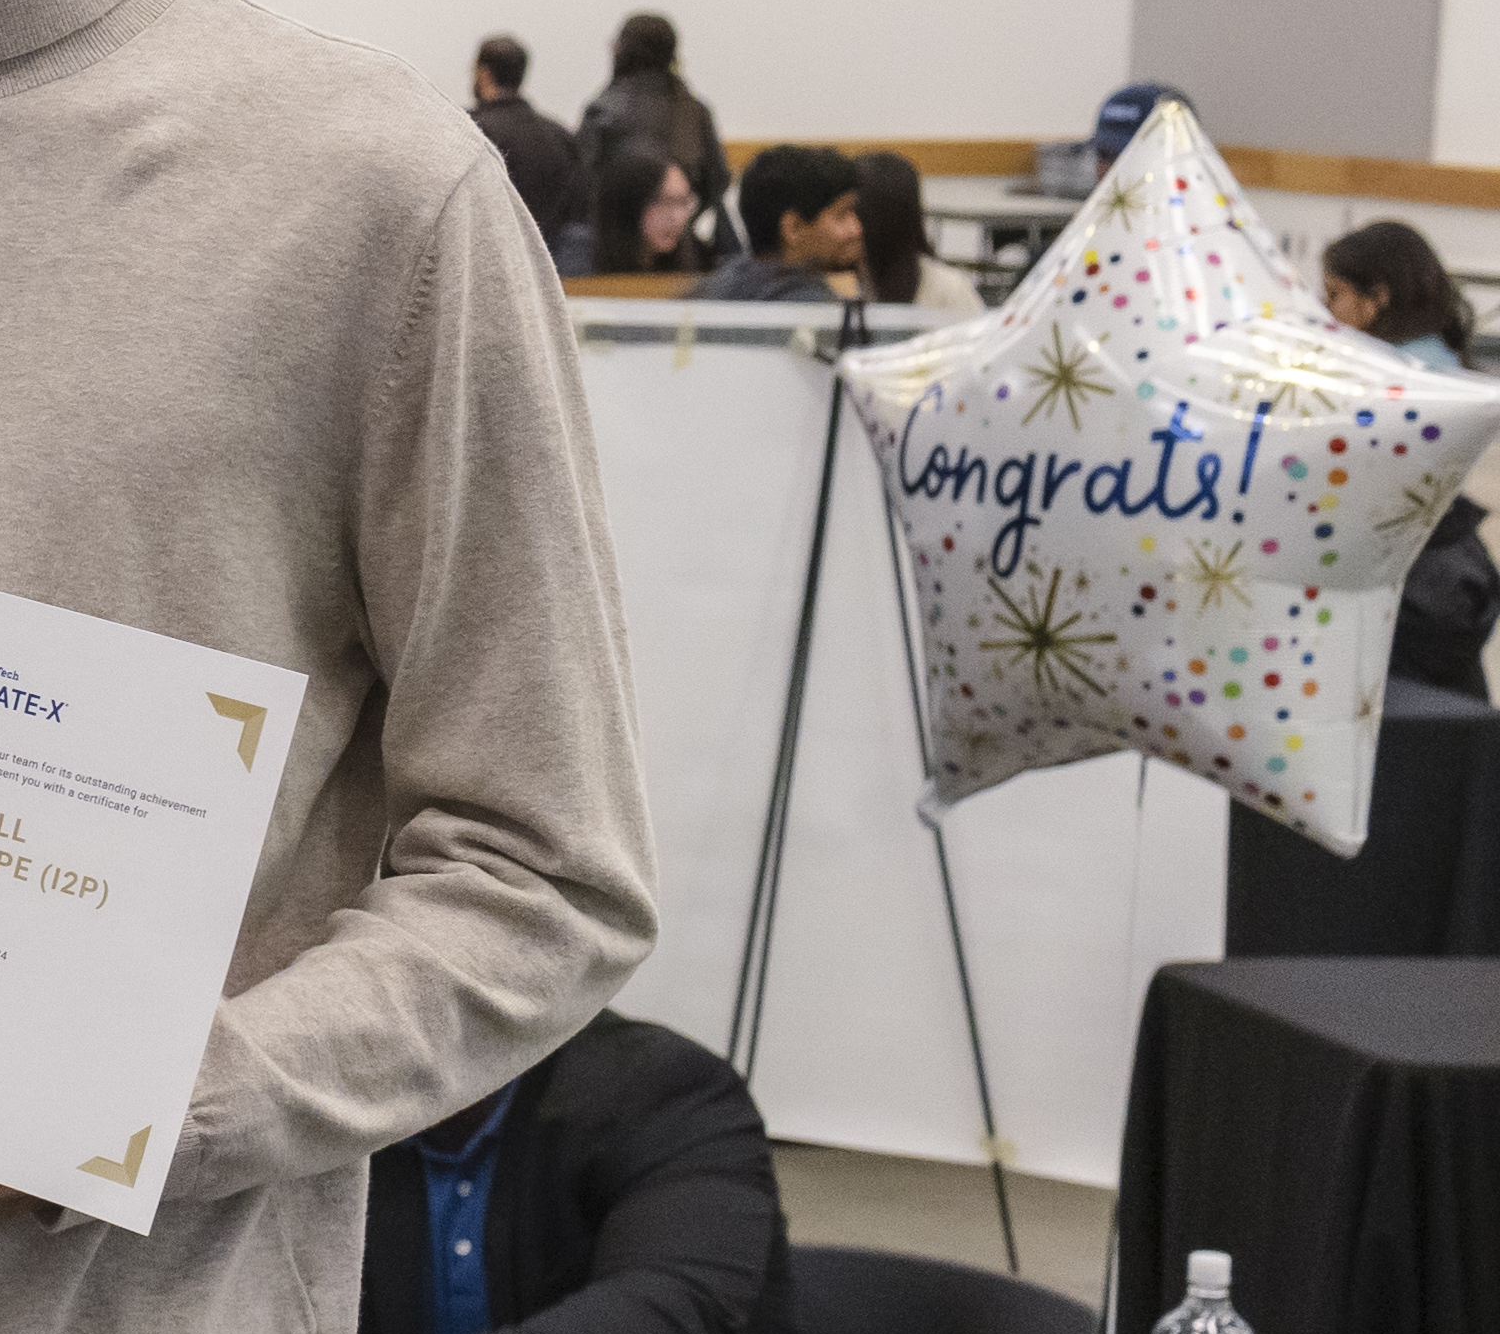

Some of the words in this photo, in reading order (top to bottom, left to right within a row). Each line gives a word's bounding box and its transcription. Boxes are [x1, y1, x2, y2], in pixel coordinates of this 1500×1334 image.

[898, 383, 1273, 579] Congrats!
[12, 754, 39, 770] team
[41, 761, 57, 775] for
[58, 768, 73, 780] its
[74, 773, 138, 801] outstanding
[139, 792, 207, 819] achievement
[20, 775, 41, 788] you
[43, 782, 66, 795] with
[67, 788, 76, 798] a
[76, 791, 131, 814] certificate
[132, 805, 149, 819] for
[40, 863, 109, 910] (I2P)
